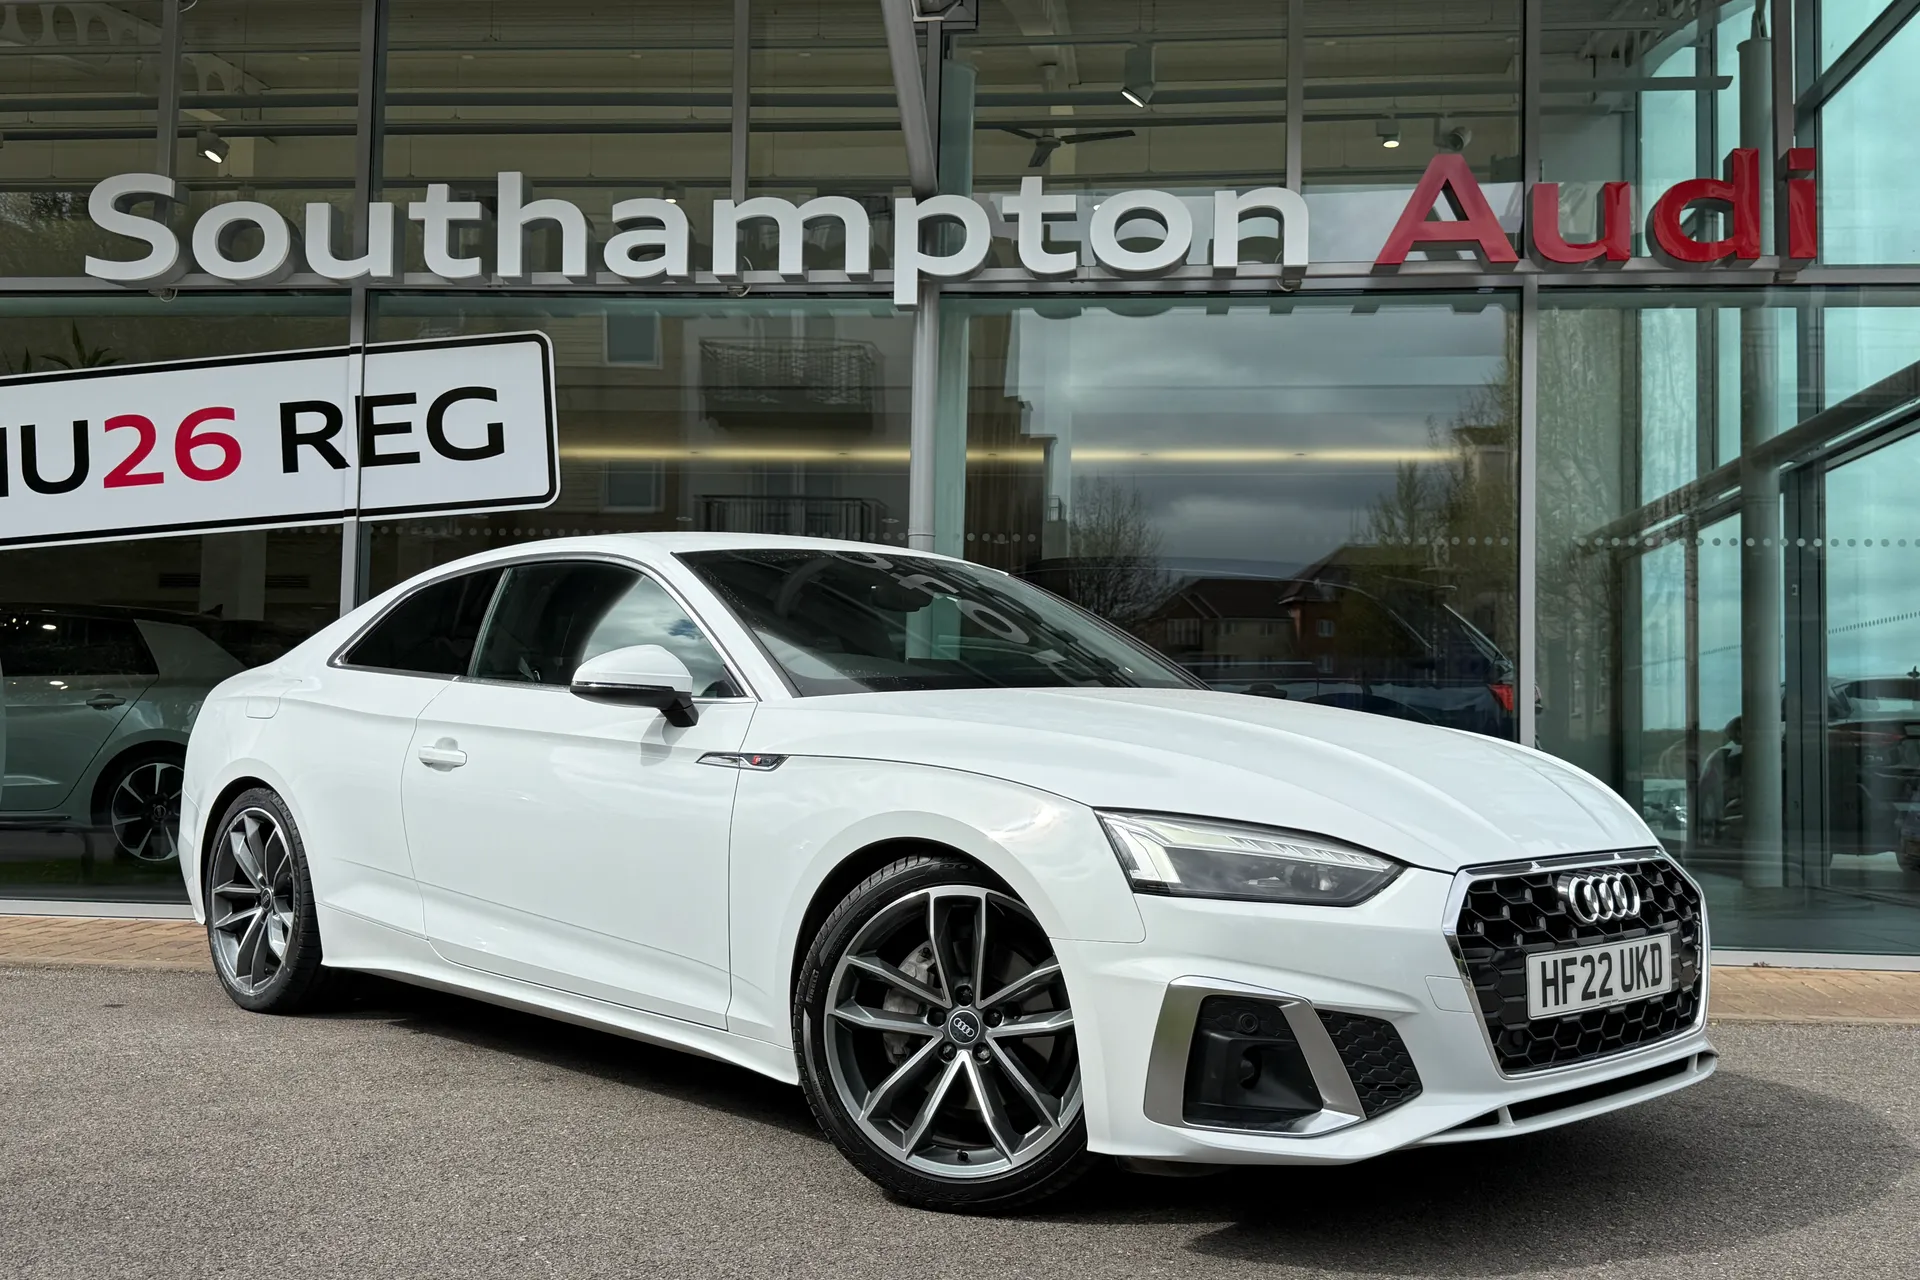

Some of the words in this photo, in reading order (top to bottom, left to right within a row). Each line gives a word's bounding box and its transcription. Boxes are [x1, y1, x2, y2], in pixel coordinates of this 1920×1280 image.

[85, 172, 1309, 306] Southampton
[1373, 148, 1816, 265] Audi
[0, 406, 242, 497] U26
[280, 386, 506, 473] REG
[1540, 953, 1613, 1008] HF22
[1620, 942, 1662, 993] UKD
